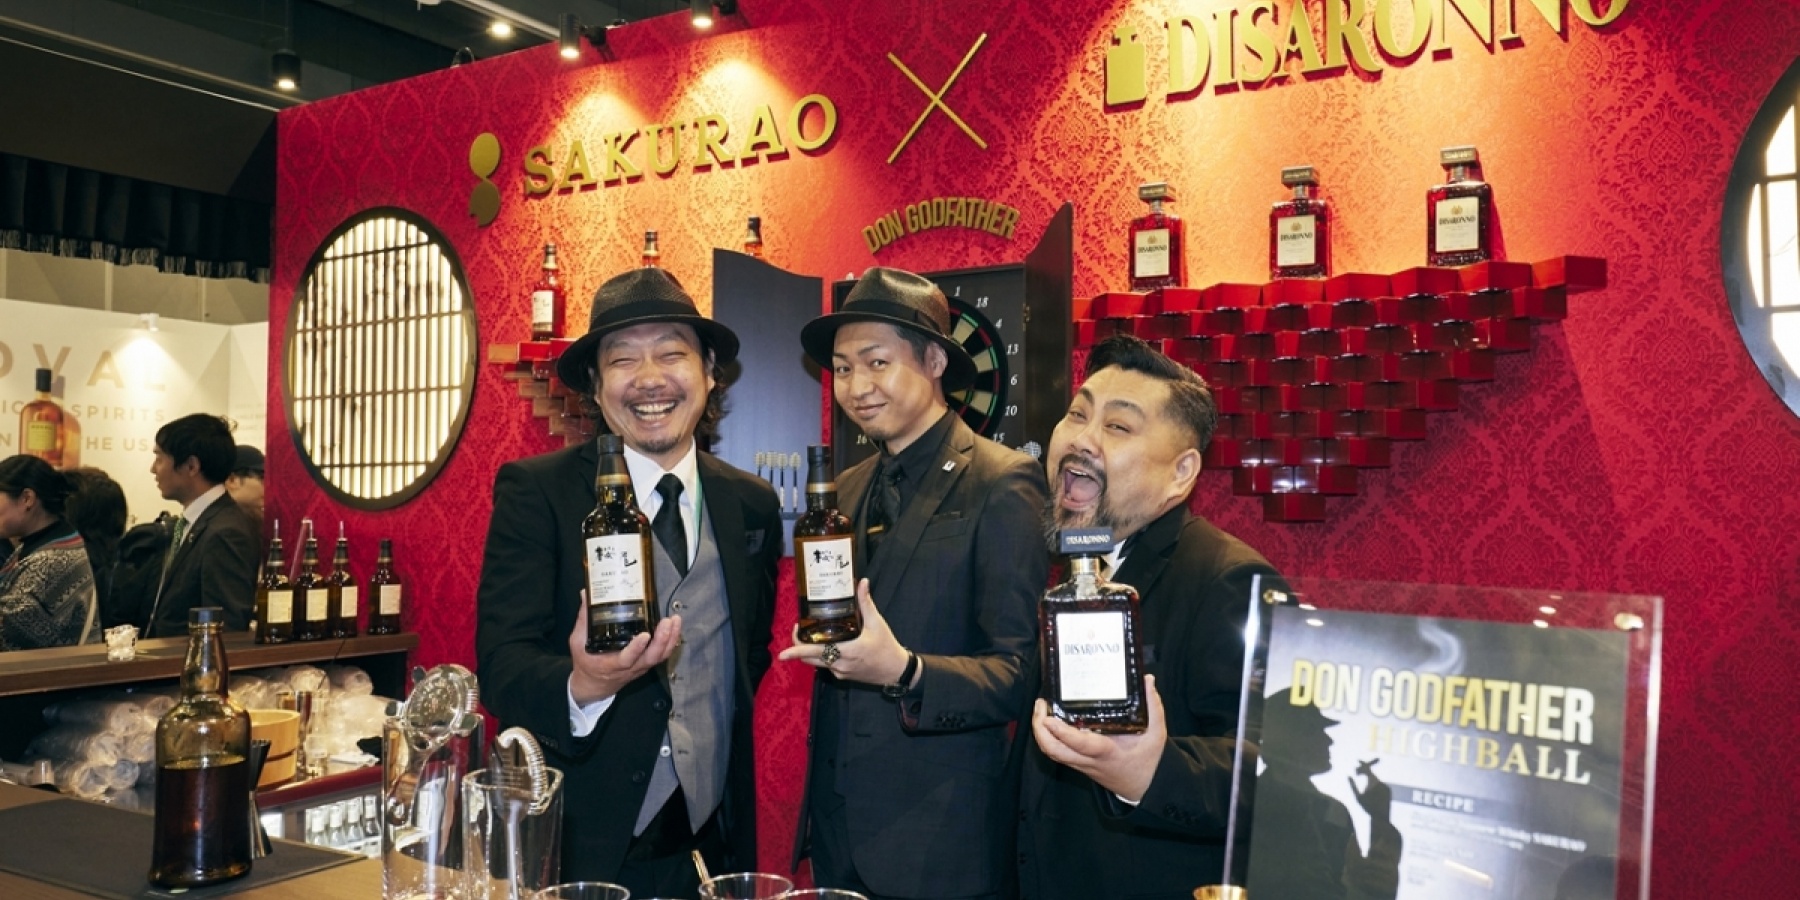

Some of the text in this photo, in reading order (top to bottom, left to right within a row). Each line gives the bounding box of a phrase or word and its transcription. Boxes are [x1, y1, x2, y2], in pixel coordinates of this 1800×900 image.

[524, 94, 837, 194] SAKURAO
[861, 197, 1020, 254] DON GODFATHER
[976, 297, 988, 308] 18
[996, 319, 1002, 328] 4
[1007, 344, 1019, 355] 13
[1010, 375, 1018, 385] 6
[71, 404, 165, 421] SPIRITS
[1005, 405, 1018, 416] 10
[81, 436, 113, 450] HE
[1066, 534, 1110, 544] DISARONNO
[1064, 643, 1120, 656] DISARONNO
[1290, 659, 1595, 745] DON GODFATHER
[1368, 722, 1590, 785] HIGHBALL
[1412, 789, 1474, 813] RECIPE
